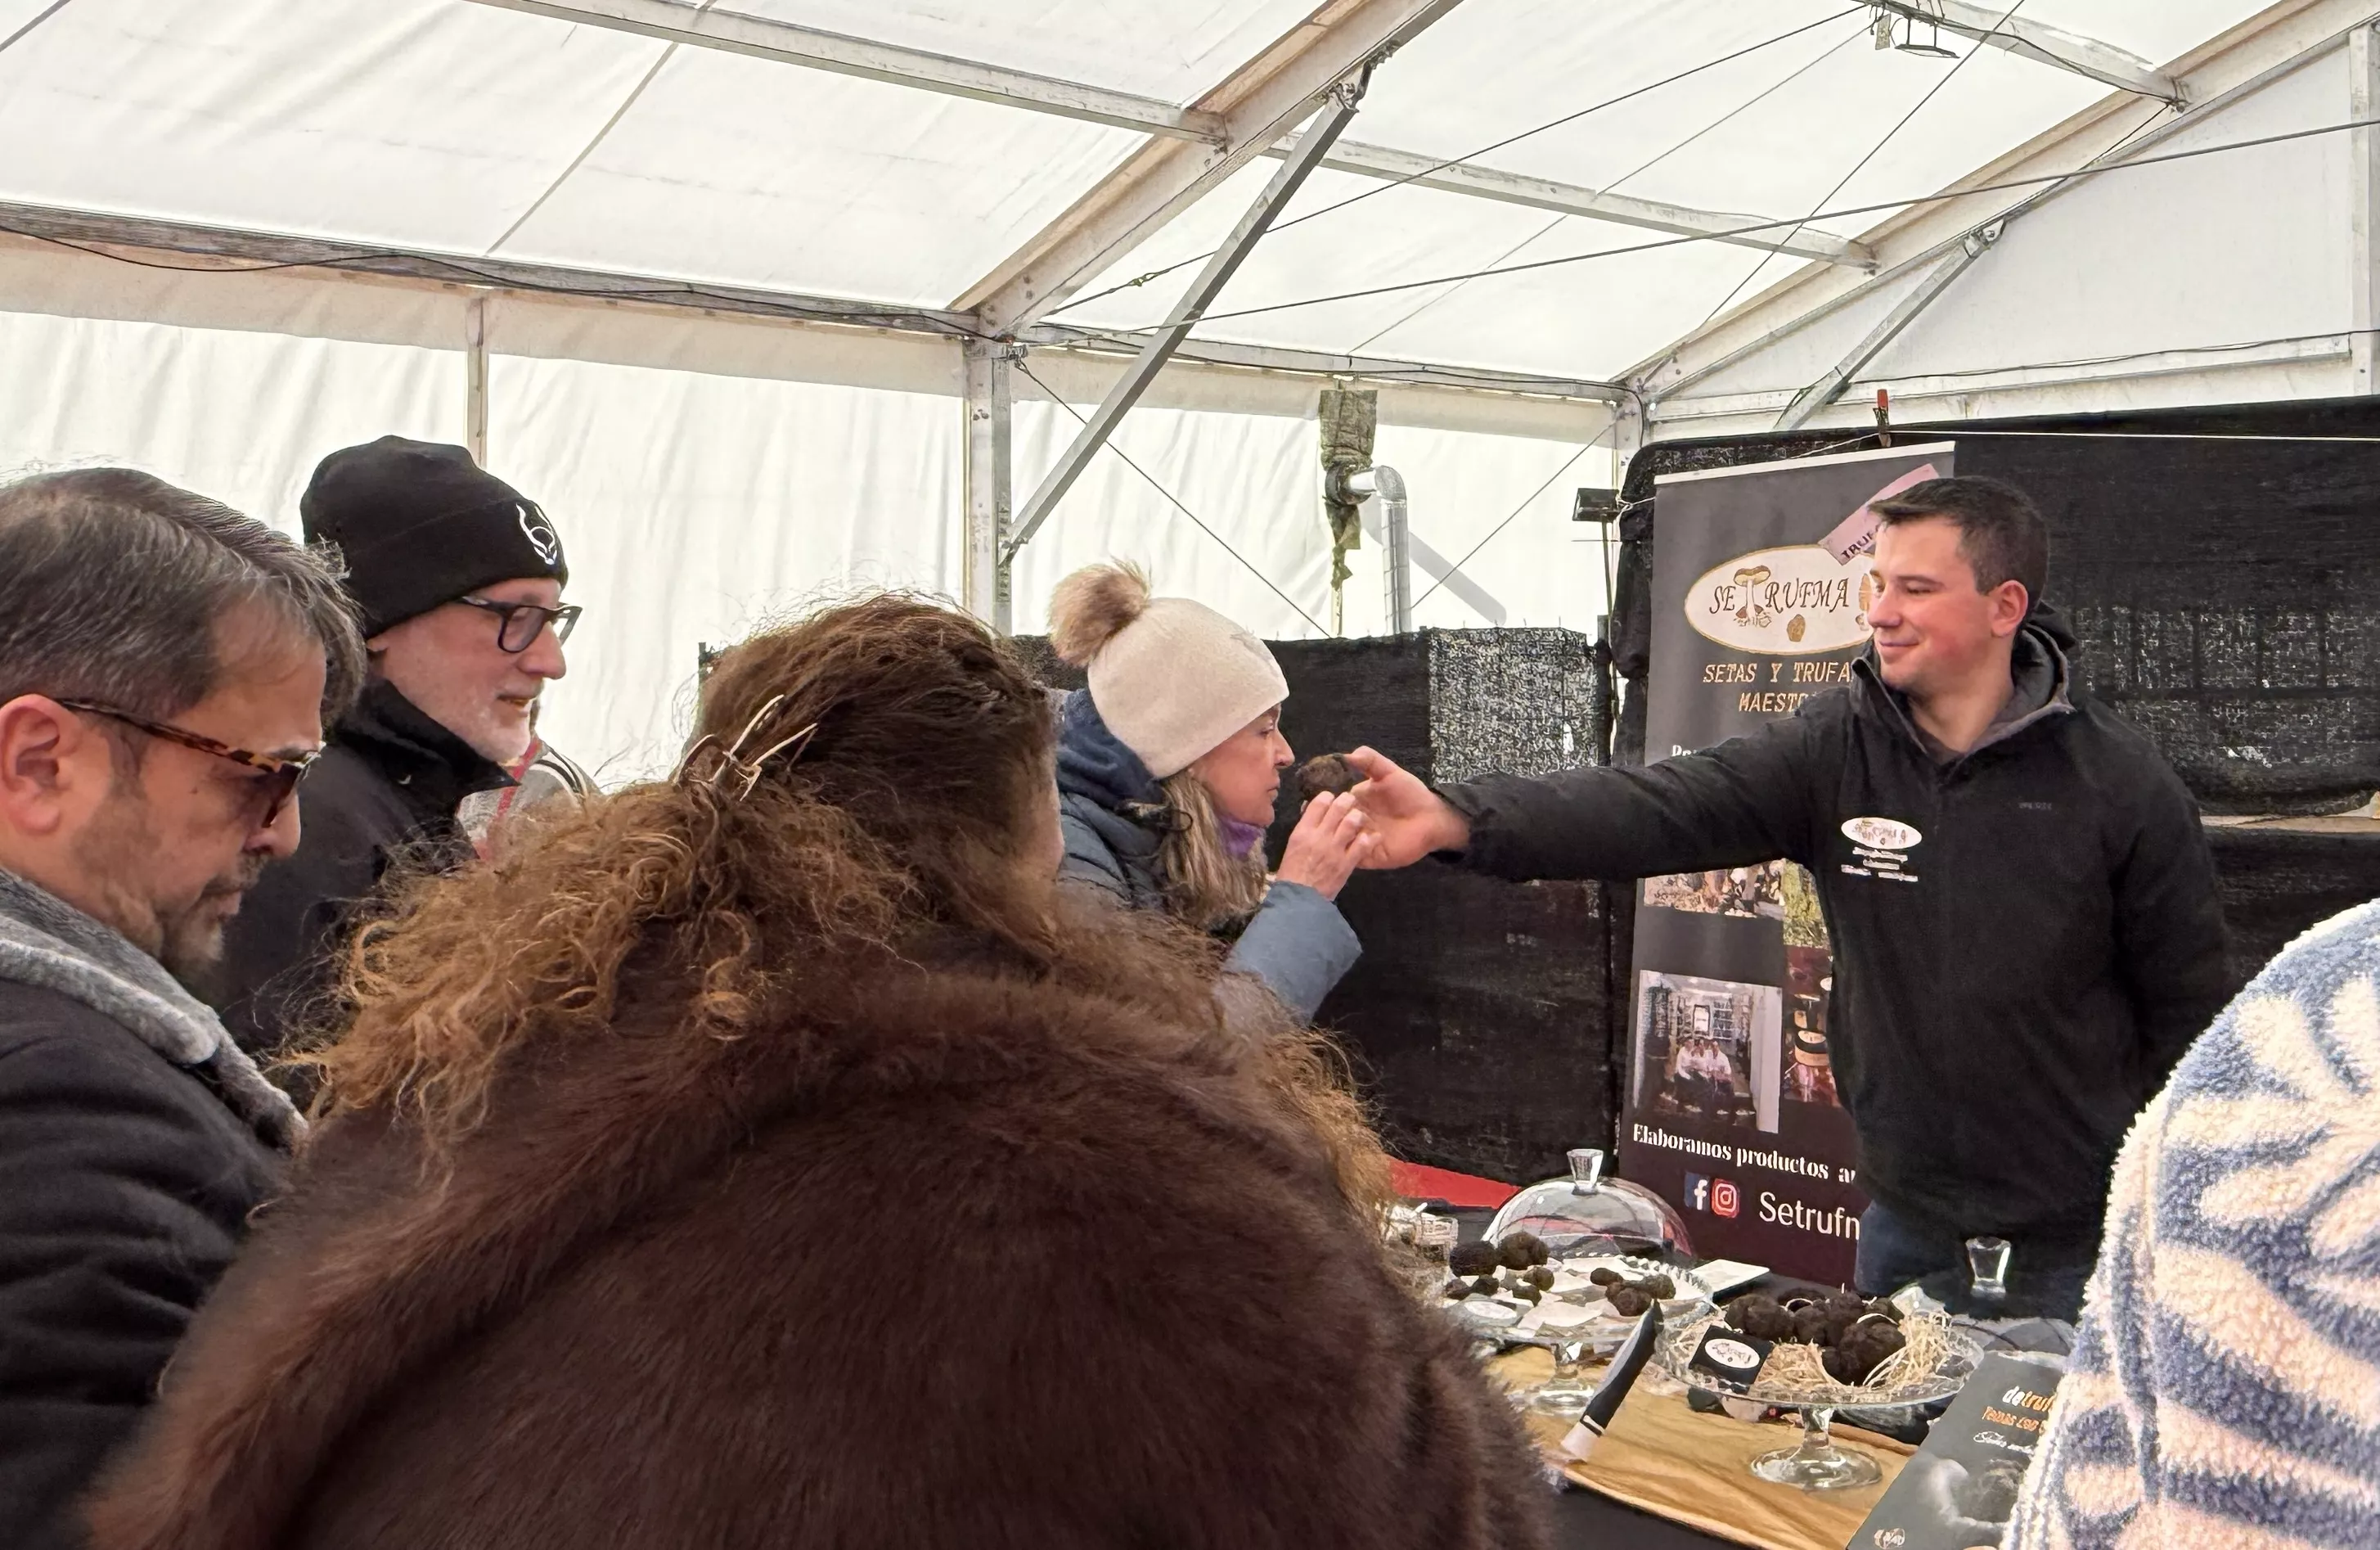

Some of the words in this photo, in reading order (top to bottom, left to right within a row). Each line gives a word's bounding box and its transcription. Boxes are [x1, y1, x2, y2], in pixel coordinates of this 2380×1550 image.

[1703, 664, 1757, 683] SETAS
[1770, 663, 1782, 683] Y
[1793, 662, 1852, 683] TRUFA
[1633, 1124, 1731, 1160] Elaboramos
[1737, 1147, 1829, 1179] productos
